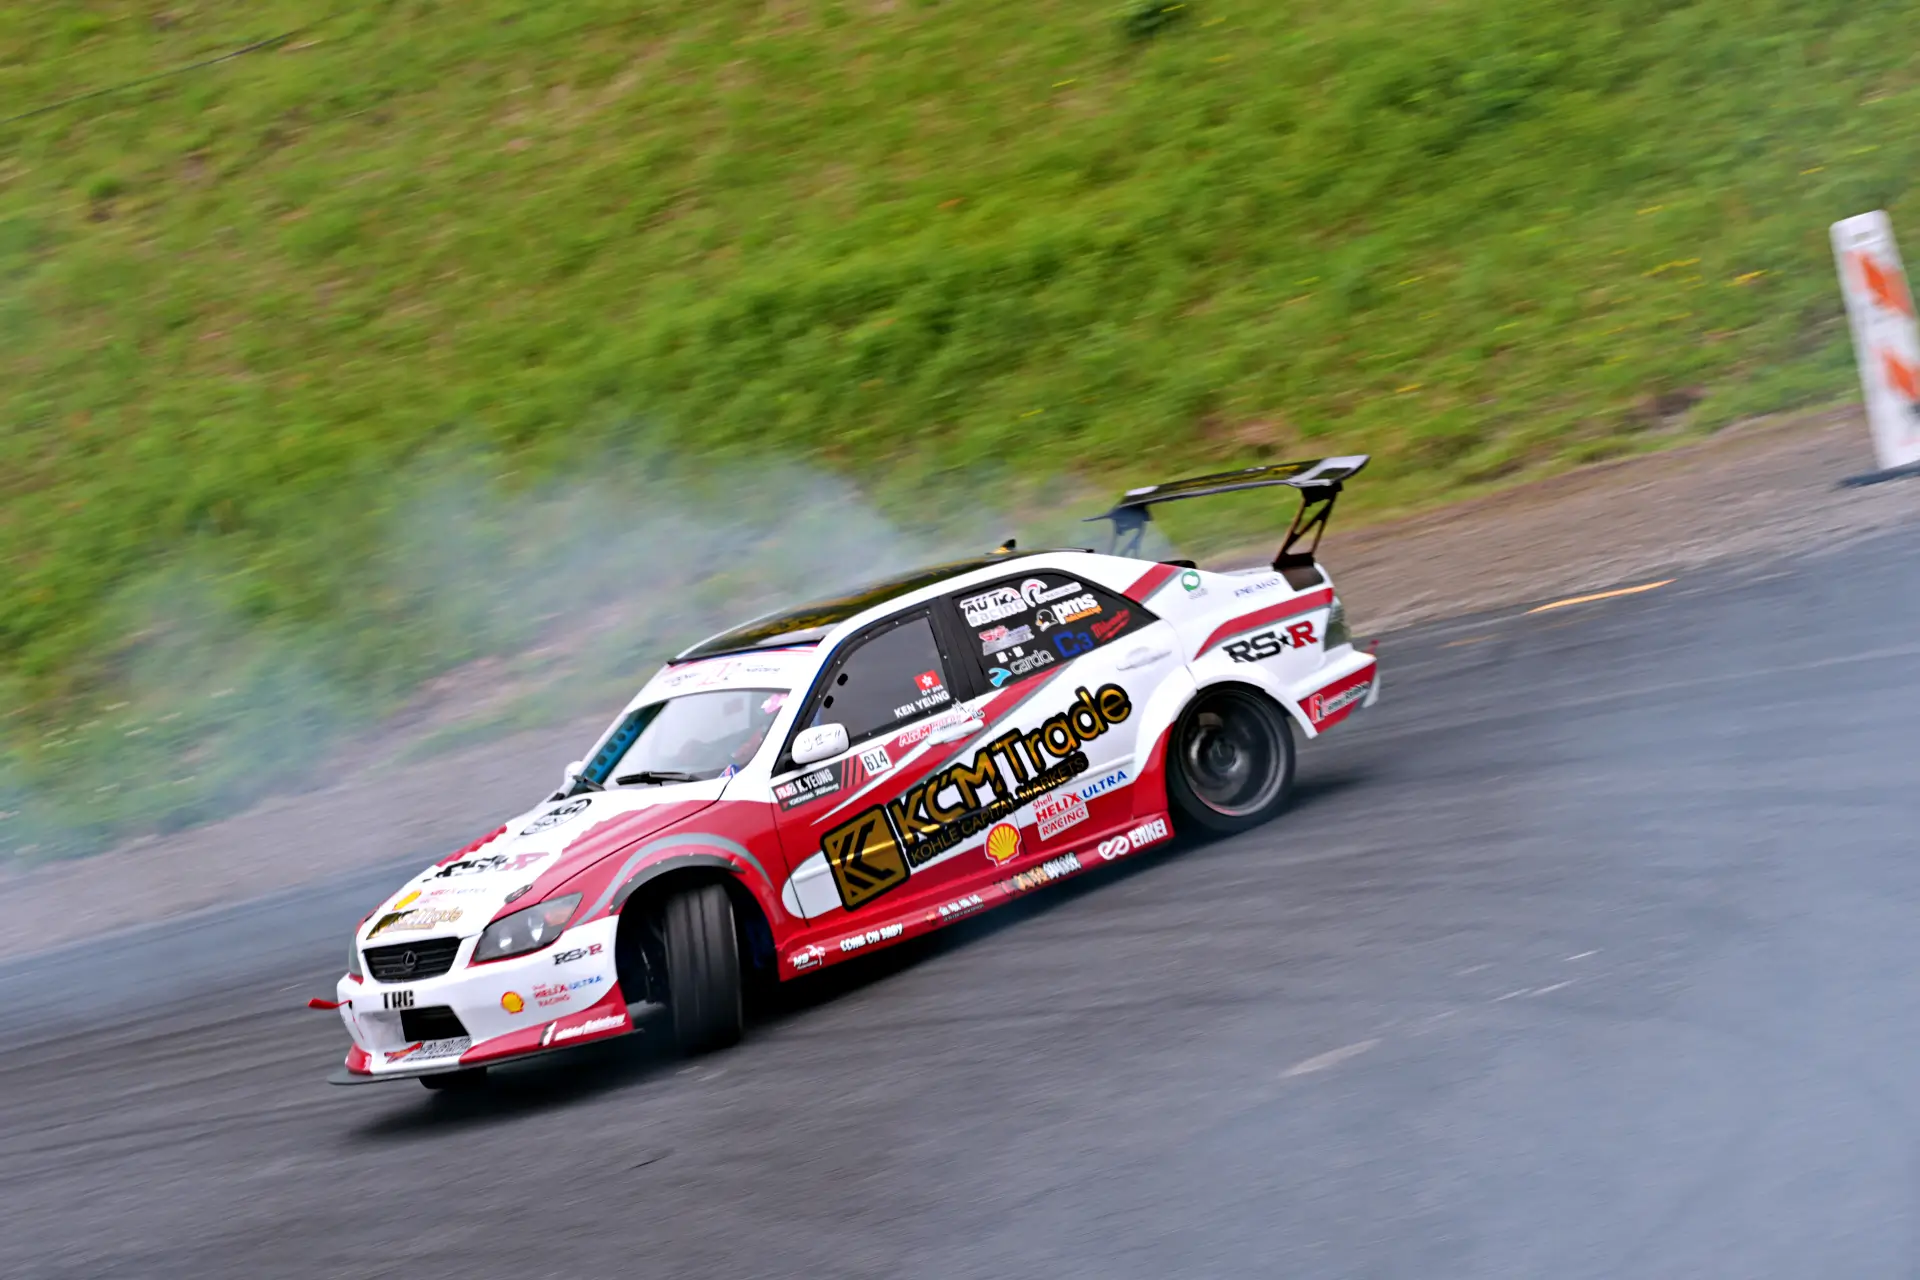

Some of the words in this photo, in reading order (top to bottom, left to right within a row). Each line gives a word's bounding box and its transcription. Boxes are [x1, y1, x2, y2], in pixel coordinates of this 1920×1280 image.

[893, 702, 916, 719] KEN
[915, 690, 950, 709] YEUNG
[863, 751, 889, 771] 614
[910, 828, 960, 863] KOHLE
[962, 798, 1016, 836] CAPITAL
[1018, 757, 1084, 797] MARKETS
[1033, 793, 1053, 810] Shell
[1036, 793, 1081, 822] HELIX
[1082, 770, 1128, 798] ULTRA
[1042, 808, 1085, 836] RACING
